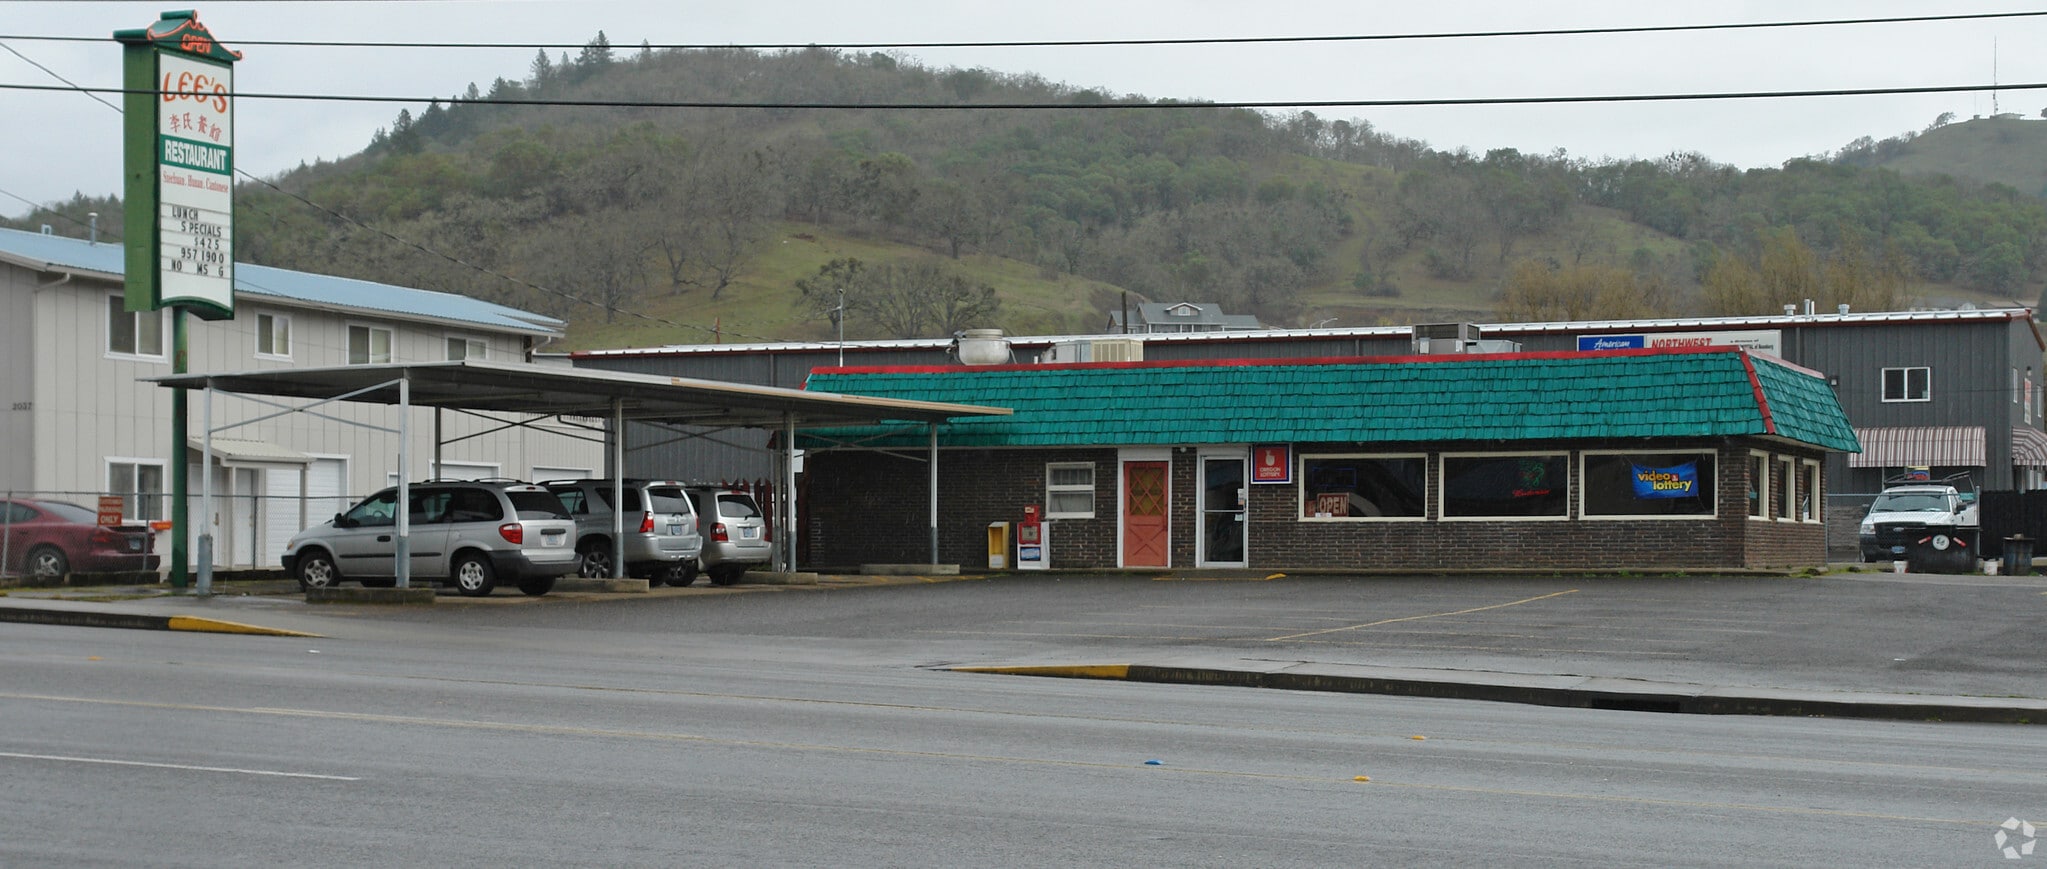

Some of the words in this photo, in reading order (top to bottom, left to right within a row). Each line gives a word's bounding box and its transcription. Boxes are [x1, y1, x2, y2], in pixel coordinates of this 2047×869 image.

[181, 33, 211, 54] OPEN
[162, 71, 227, 114] LEE'S
[164, 139, 226, 171] RESTAURANT
[172, 205, 198, 221] LUNCH
[181, 247, 197, 260] 957
[171, 258, 182, 272] NO
[1593, 338, 1631, 349] American
[1651, 337, 1712, 348] NORTHWEST
[1637, 470, 1671, 481] video
[1652, 479, 1692, 492] lottery
[1319, 496, 1347, 515] OPEN
[100, 515, 119, 525] ONLY
